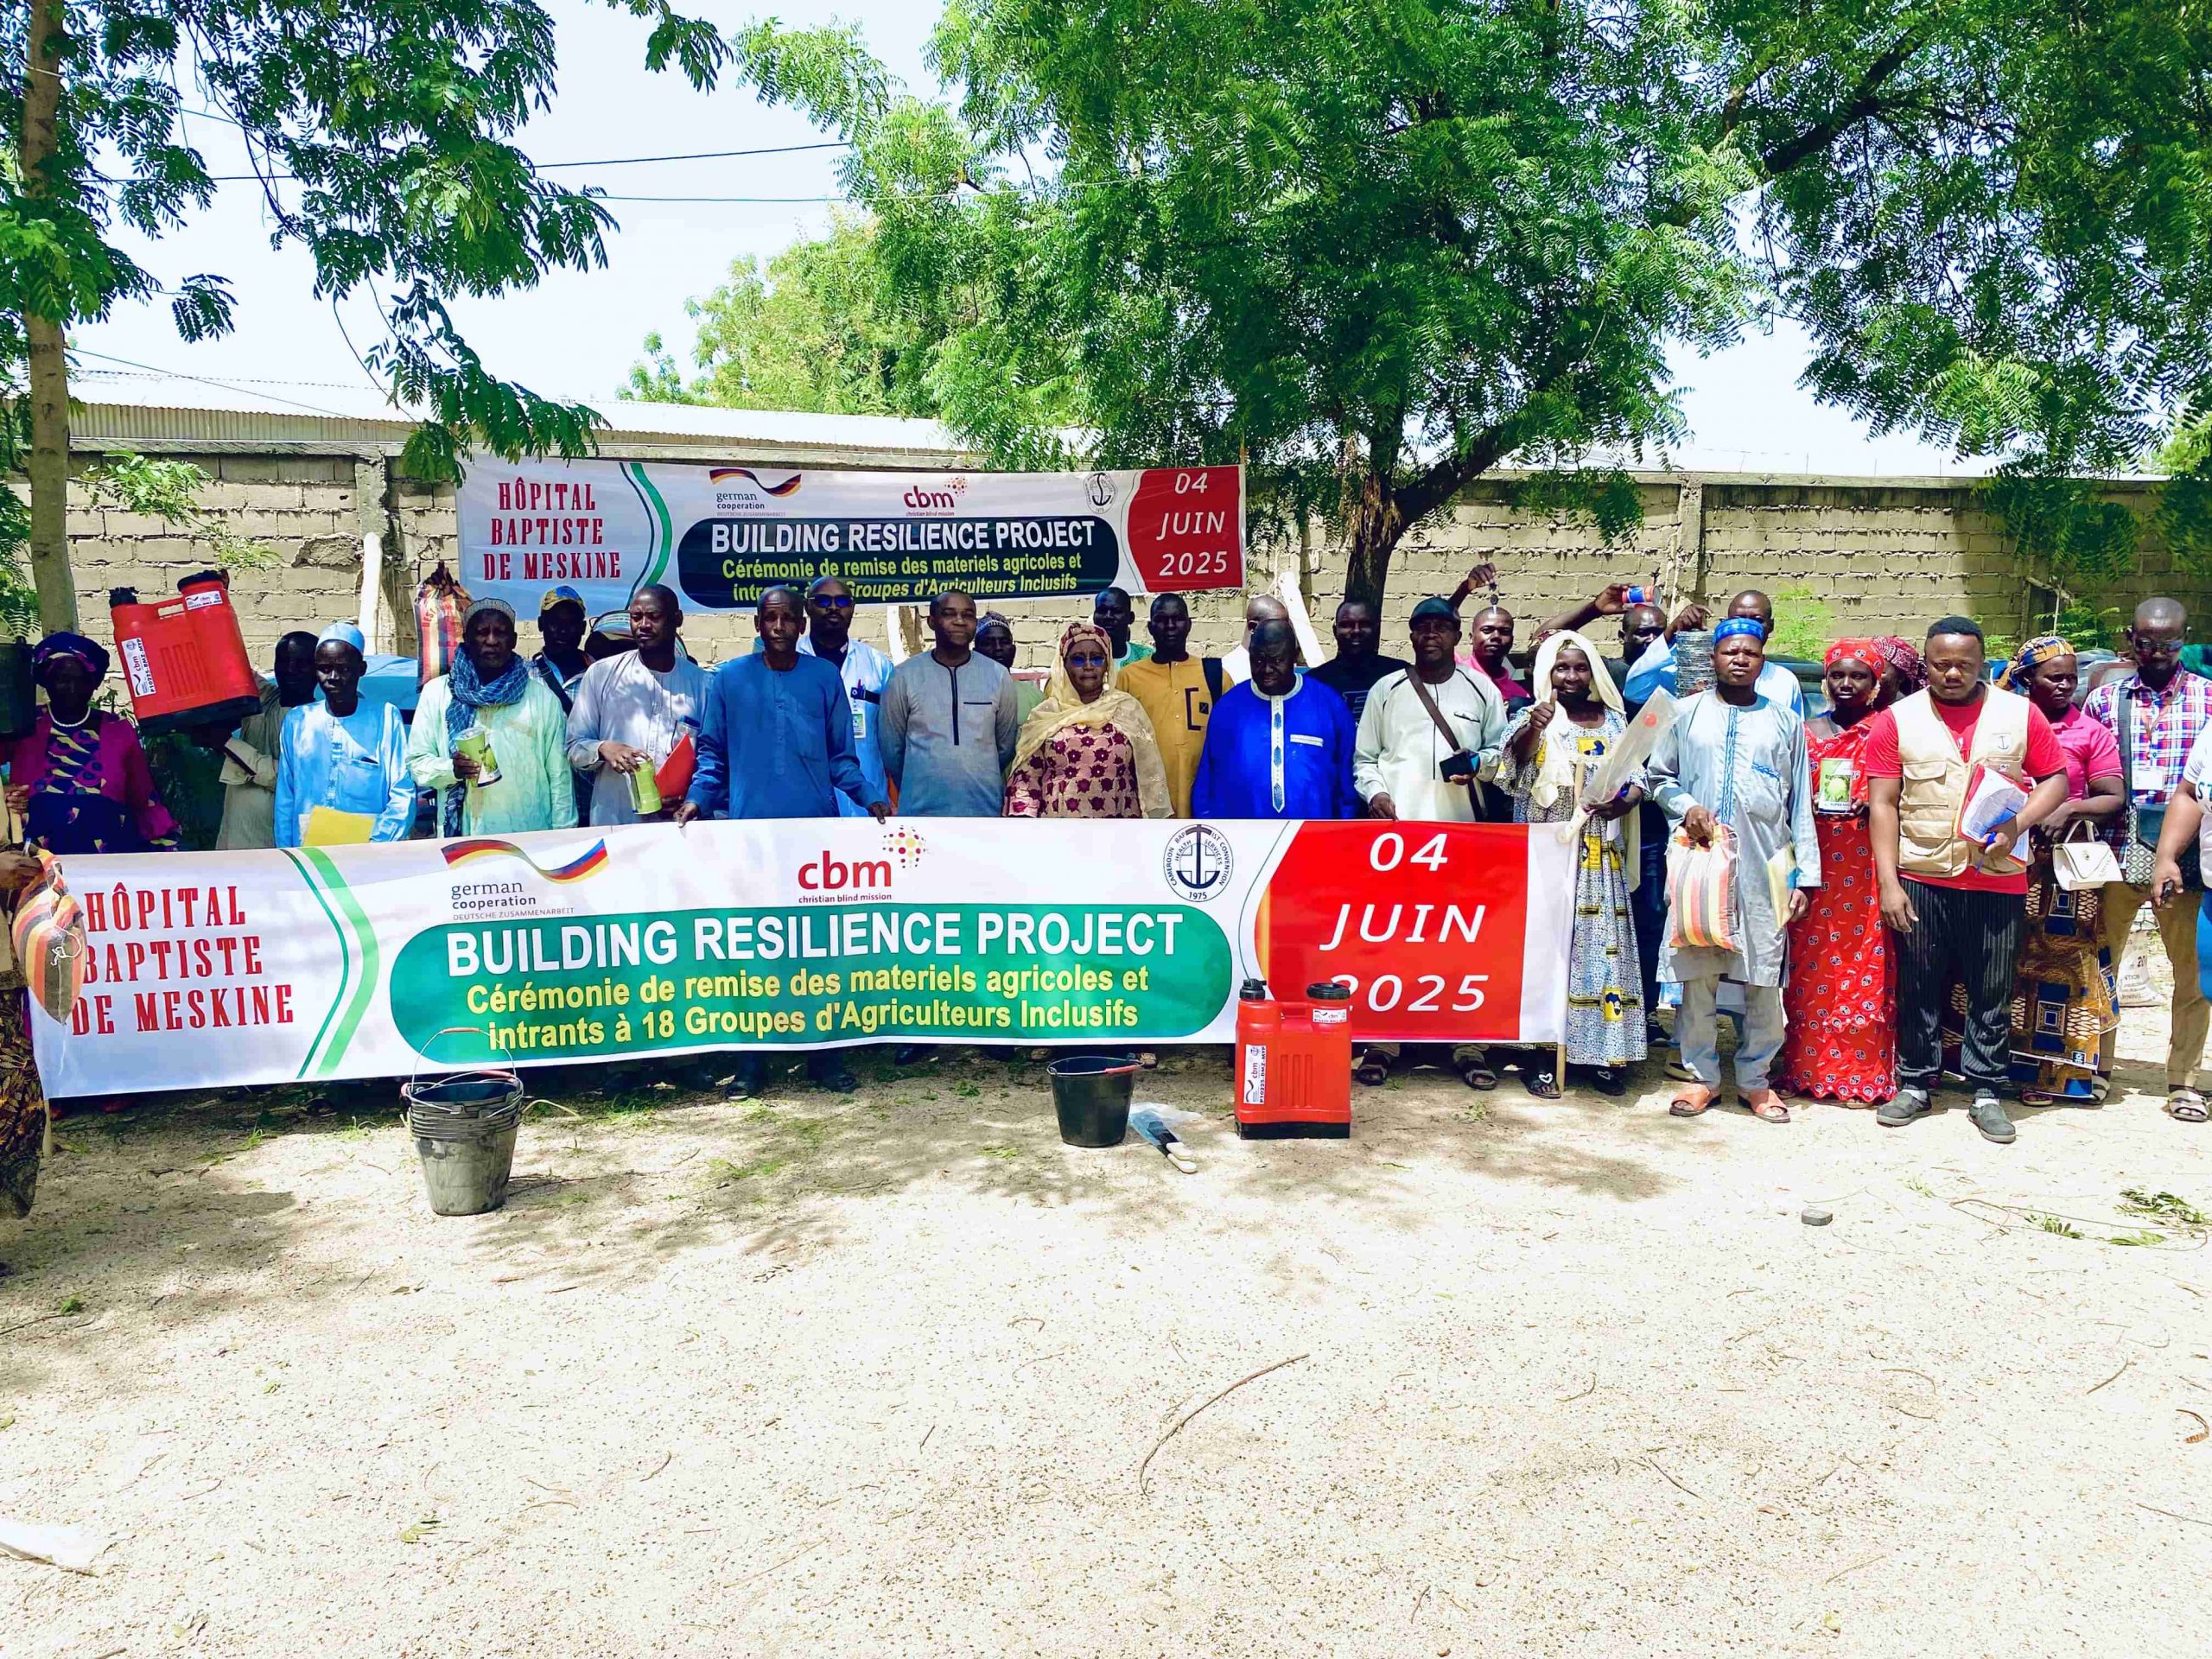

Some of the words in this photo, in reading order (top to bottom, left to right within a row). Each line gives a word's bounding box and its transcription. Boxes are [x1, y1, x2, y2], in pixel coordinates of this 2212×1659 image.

[499, 477, 595, 510] HÔPITAL
[716, 493, 757, 502] german
[903, 486, 955, 507] cbm
[1174, 473, 1208, 494] 04
[491, 518, 602, 545] BAPTISTE
[711, 524, 840, 553] BUILDING
[849, 522, 989, 551] RESILIENCE
[996, 520, 1096, 548] PROJECT
[1156, 512, 1225, 541] JUIN
[484, 554, 511, 580] DE
[524, 552, 620, 579] MESKINE
[722, 557, 815, 579] Cérémonie
[819, 559, 839, 576] de
[843, 559, 896, 576] remise
[901, 556, 928, 575] des
[932, 552, 999, 573] materiels
[1002, 550, 1065, 575] agricoles
[1069, 552, 1082, 569] et
[1159, 550, 1228, 576] 2025
[1020, 572, 1077, 592] Inclusifs
[133, 655, 142, 672] cbm
[1175, 840, 1192, 861] HEALTH
[1205, 839, 1223, 865] SERVICES
[1219, 842, 1230, 887] CONVENTION
[1370, 832, 1448, 872] 04
[798, 850, 892, 890] cbm
[451, 882, 524, 899] german
[452, 895, 537, 911] cooperation
[798, 895, 835, 904] christian
[836, 893, 858, 902] blind
[84, 881, 246, 933] HÔPITAL
[453, 912, 497, 921] DEUTSCHE
[499, 907, 575, 918] ZUSAMMENARBEIT
[1319, 903, 1486, 951] JUIN
[447, 920, 678, 977] BUILDING
[695, 912, 962, 961] RESILIENCE
[977, 912, 1184, 955] PROJECT
[83, 936, 263, 984] BAPTISTE
[467, 977, 630, 1014] Cérémonie
[640, 975, 676, 1003] de
[685, 969, 780, 1000] remise
[790, 968, 841, 996] des
[850, 963, 977, 993] materiels
[987, 964, 1114, 999] agricoles
[1122, 965, 1149, 991] et
[72, 995, 115, 1036] DE
[134, 984, 294, 1033] MESKINE
[489, 1018, 605, 1050] intrants
[614, 1013, 632, 1043] à
[643, 1009, 675, 1039] 18
[685, 1007, 806, 1039] Groupes
[815, 999, 1010, 1034] d'Agriculteurs
[1020, 996, 1139, 1027] Inclusifs
[1250, 1062, 1259, 1079] cbm
